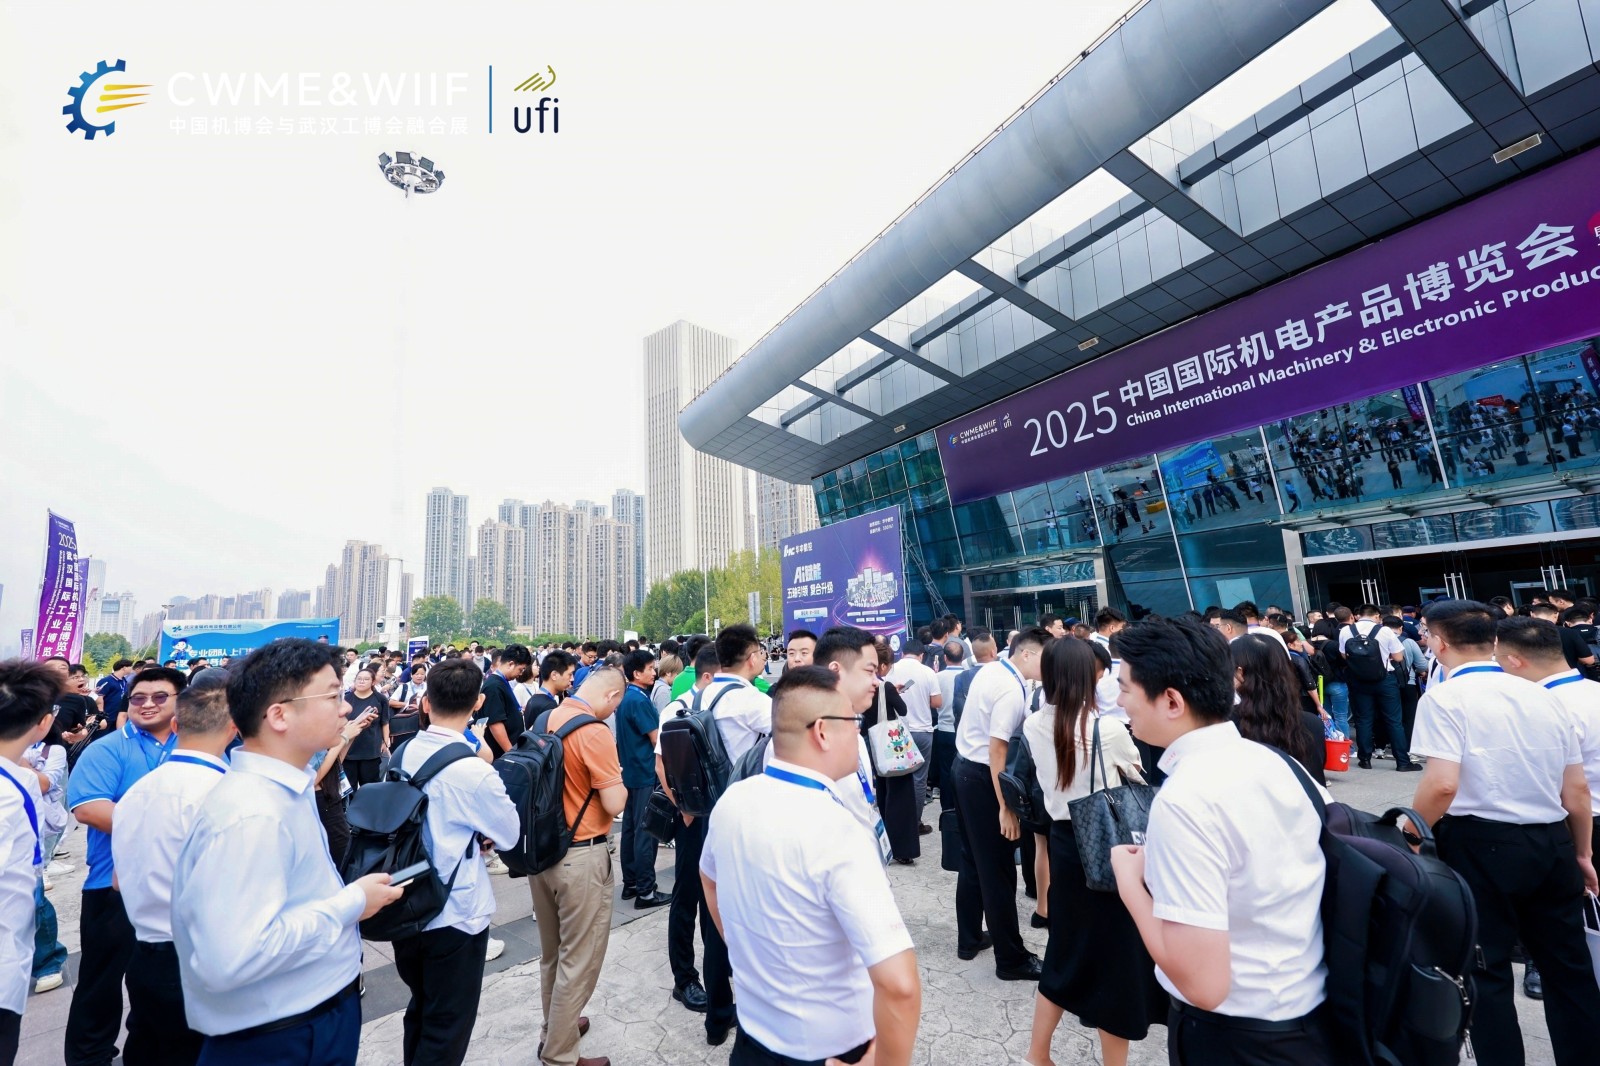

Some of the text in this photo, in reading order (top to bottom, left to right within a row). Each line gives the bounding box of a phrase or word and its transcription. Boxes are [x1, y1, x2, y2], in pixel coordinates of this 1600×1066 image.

[1119, 223, 1579, 408] 中国国际机电产品博览会
[1126, 265, 1600, 427] China International Machinery & Electronic Produc
[959, 419, 997, 440] CWME&WIIF
[1023, 390, 1118, 457] 2025
[58, 532, 77, 551] 2025
